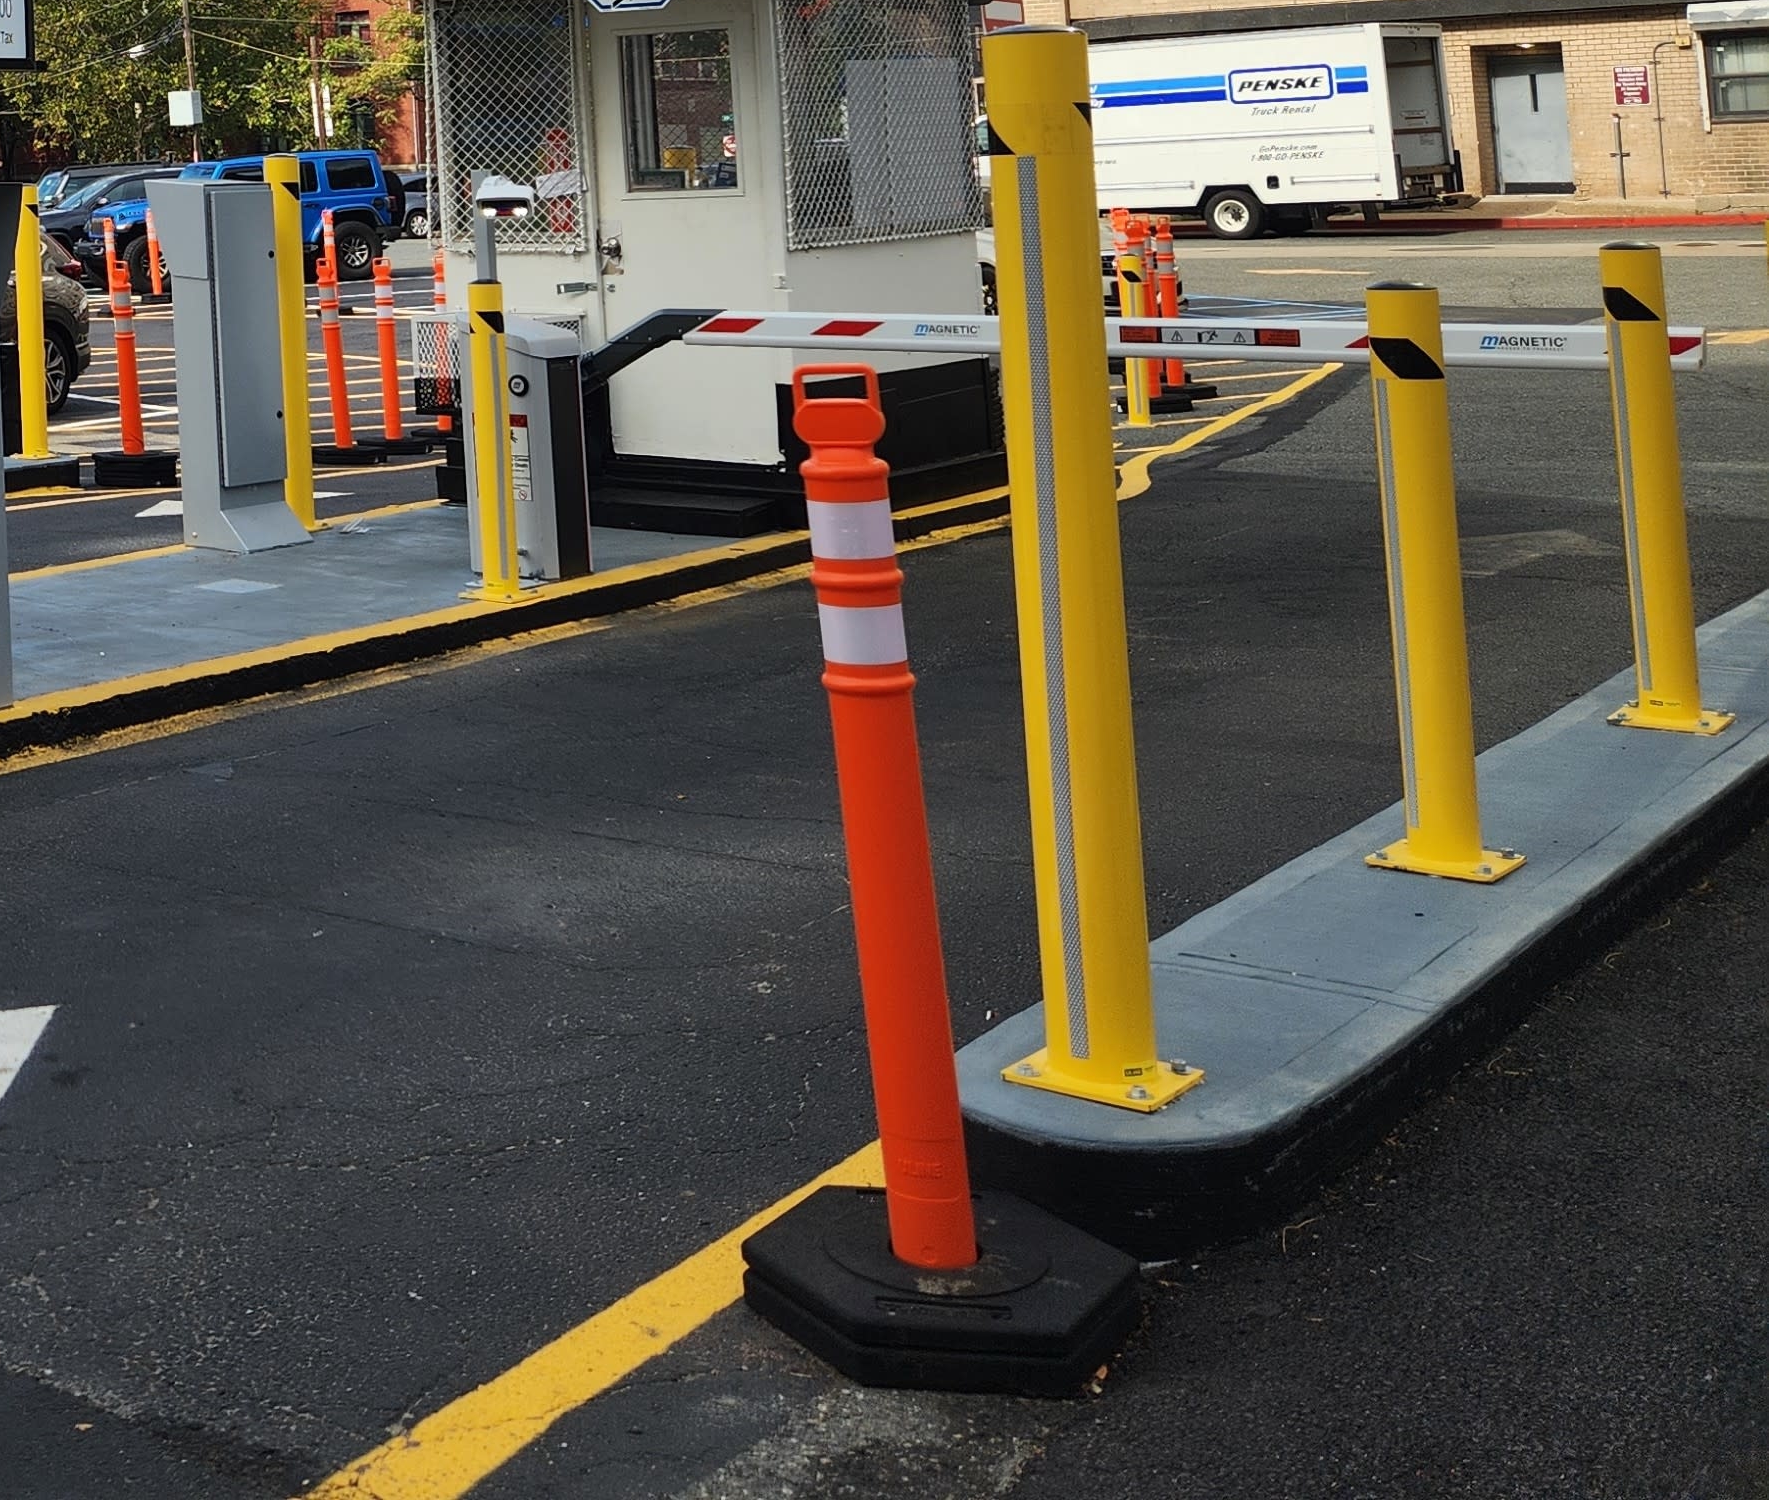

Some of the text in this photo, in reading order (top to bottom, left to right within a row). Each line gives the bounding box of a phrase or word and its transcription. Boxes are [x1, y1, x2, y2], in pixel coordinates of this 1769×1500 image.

[2, 31, 13, 44] Tax
[1238, 76, 1324, 92] PENSKE
[1251, 104, 1316, 116] Truck Rental
